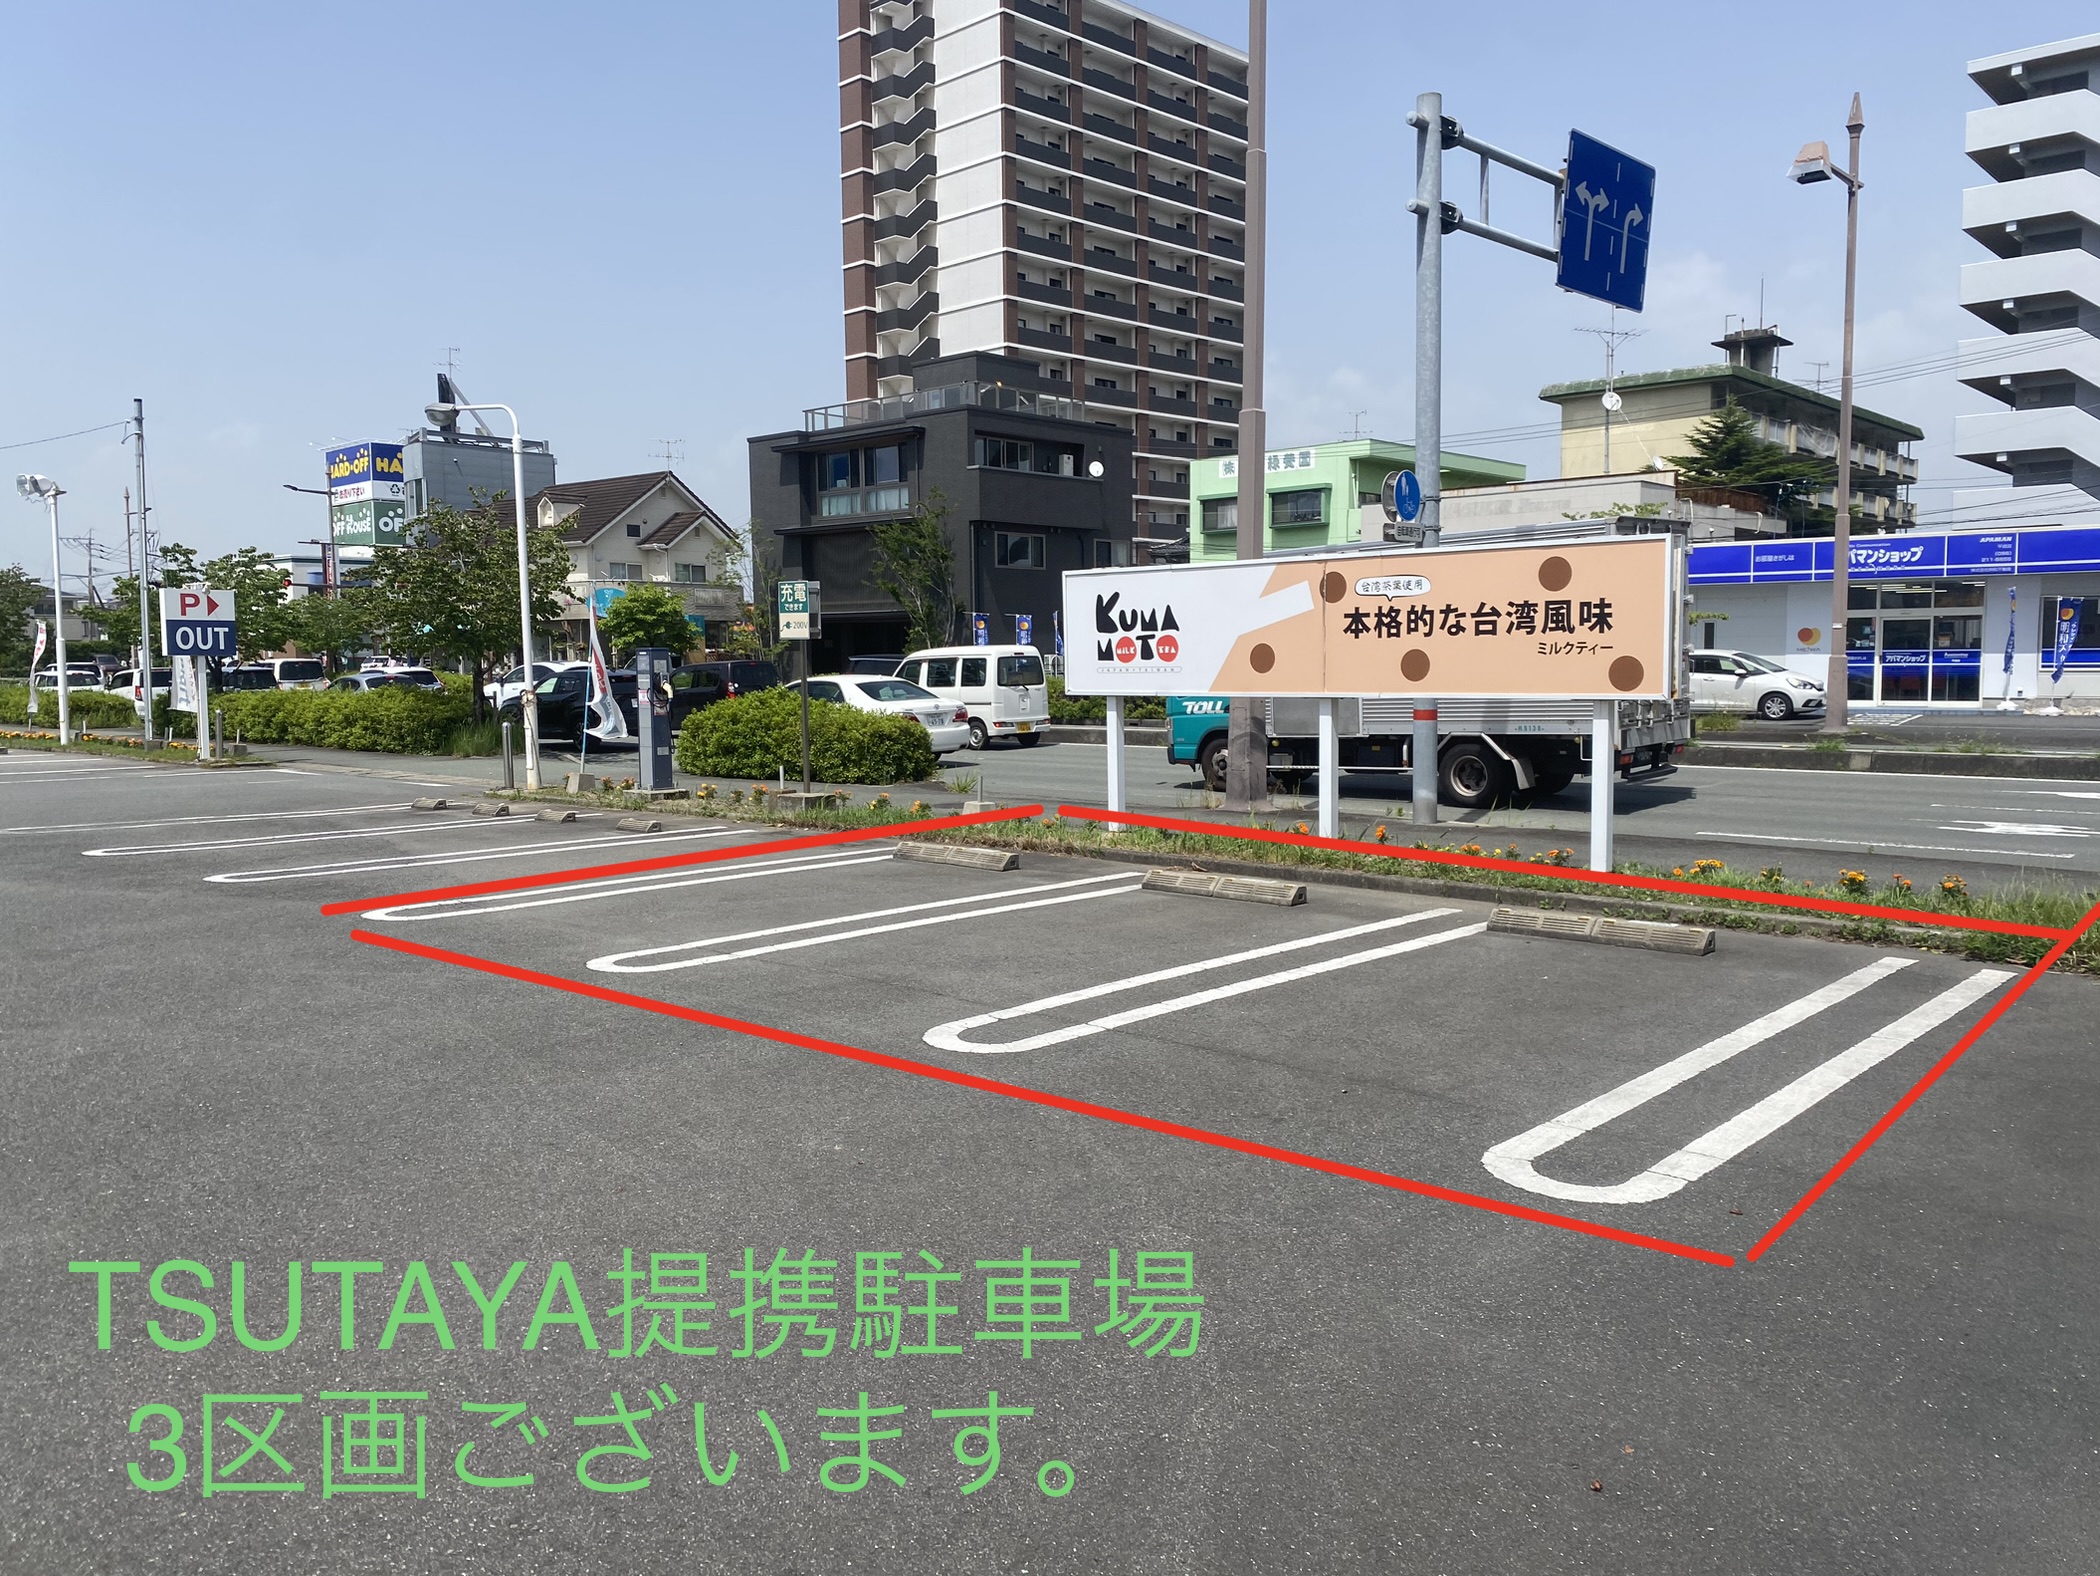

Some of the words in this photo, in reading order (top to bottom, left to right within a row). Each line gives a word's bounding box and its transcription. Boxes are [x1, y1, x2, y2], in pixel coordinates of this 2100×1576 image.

[1848, 546, 1924, 564] パマンショップ
[781, 584, 806, 602] 充電
[1361, 579, 1424, 593] 台湾茶葉使用
[180, 593, 200, 616] P
[784, 603, 803, 611] できます
[1095, 591, 1180, 634] KUMA
[1343, 598, 1614, 639] 本格的な台湾風味
[175, 626, 229, 650] OUT
[1158, 645, 1176, 654] TEA
[1537, 641, 1613, 655] ミルクティー
[1885, 654, 1927, 662] アパマンショップ
[1182, 700, 1225, 715] TOLL
